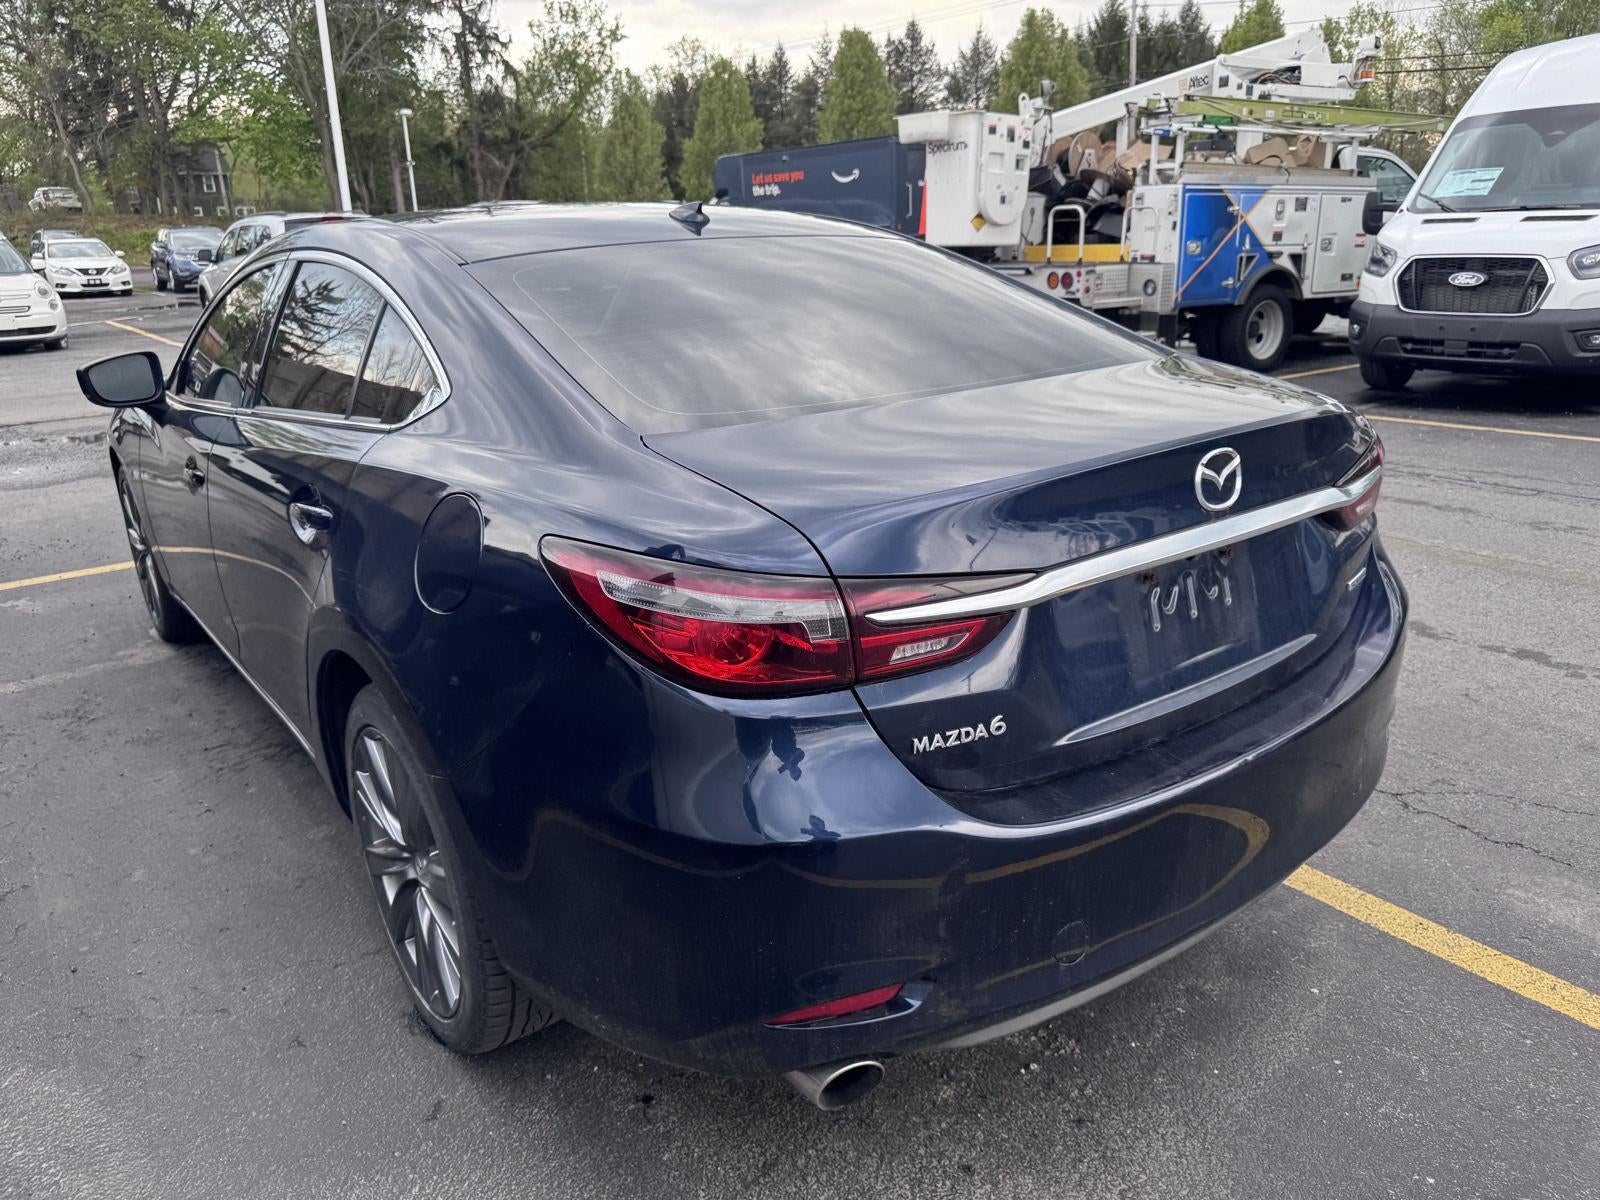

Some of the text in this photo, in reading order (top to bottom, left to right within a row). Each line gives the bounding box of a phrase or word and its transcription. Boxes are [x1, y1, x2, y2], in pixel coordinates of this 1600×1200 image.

[1189, 75, 1209, 91] Altec
[927, 140, 968, 156] Spectrum
[752, 172, 763, 185] Let
[752, 184, 764, 196] the
[1453, 273, 1479, 285] Ford
